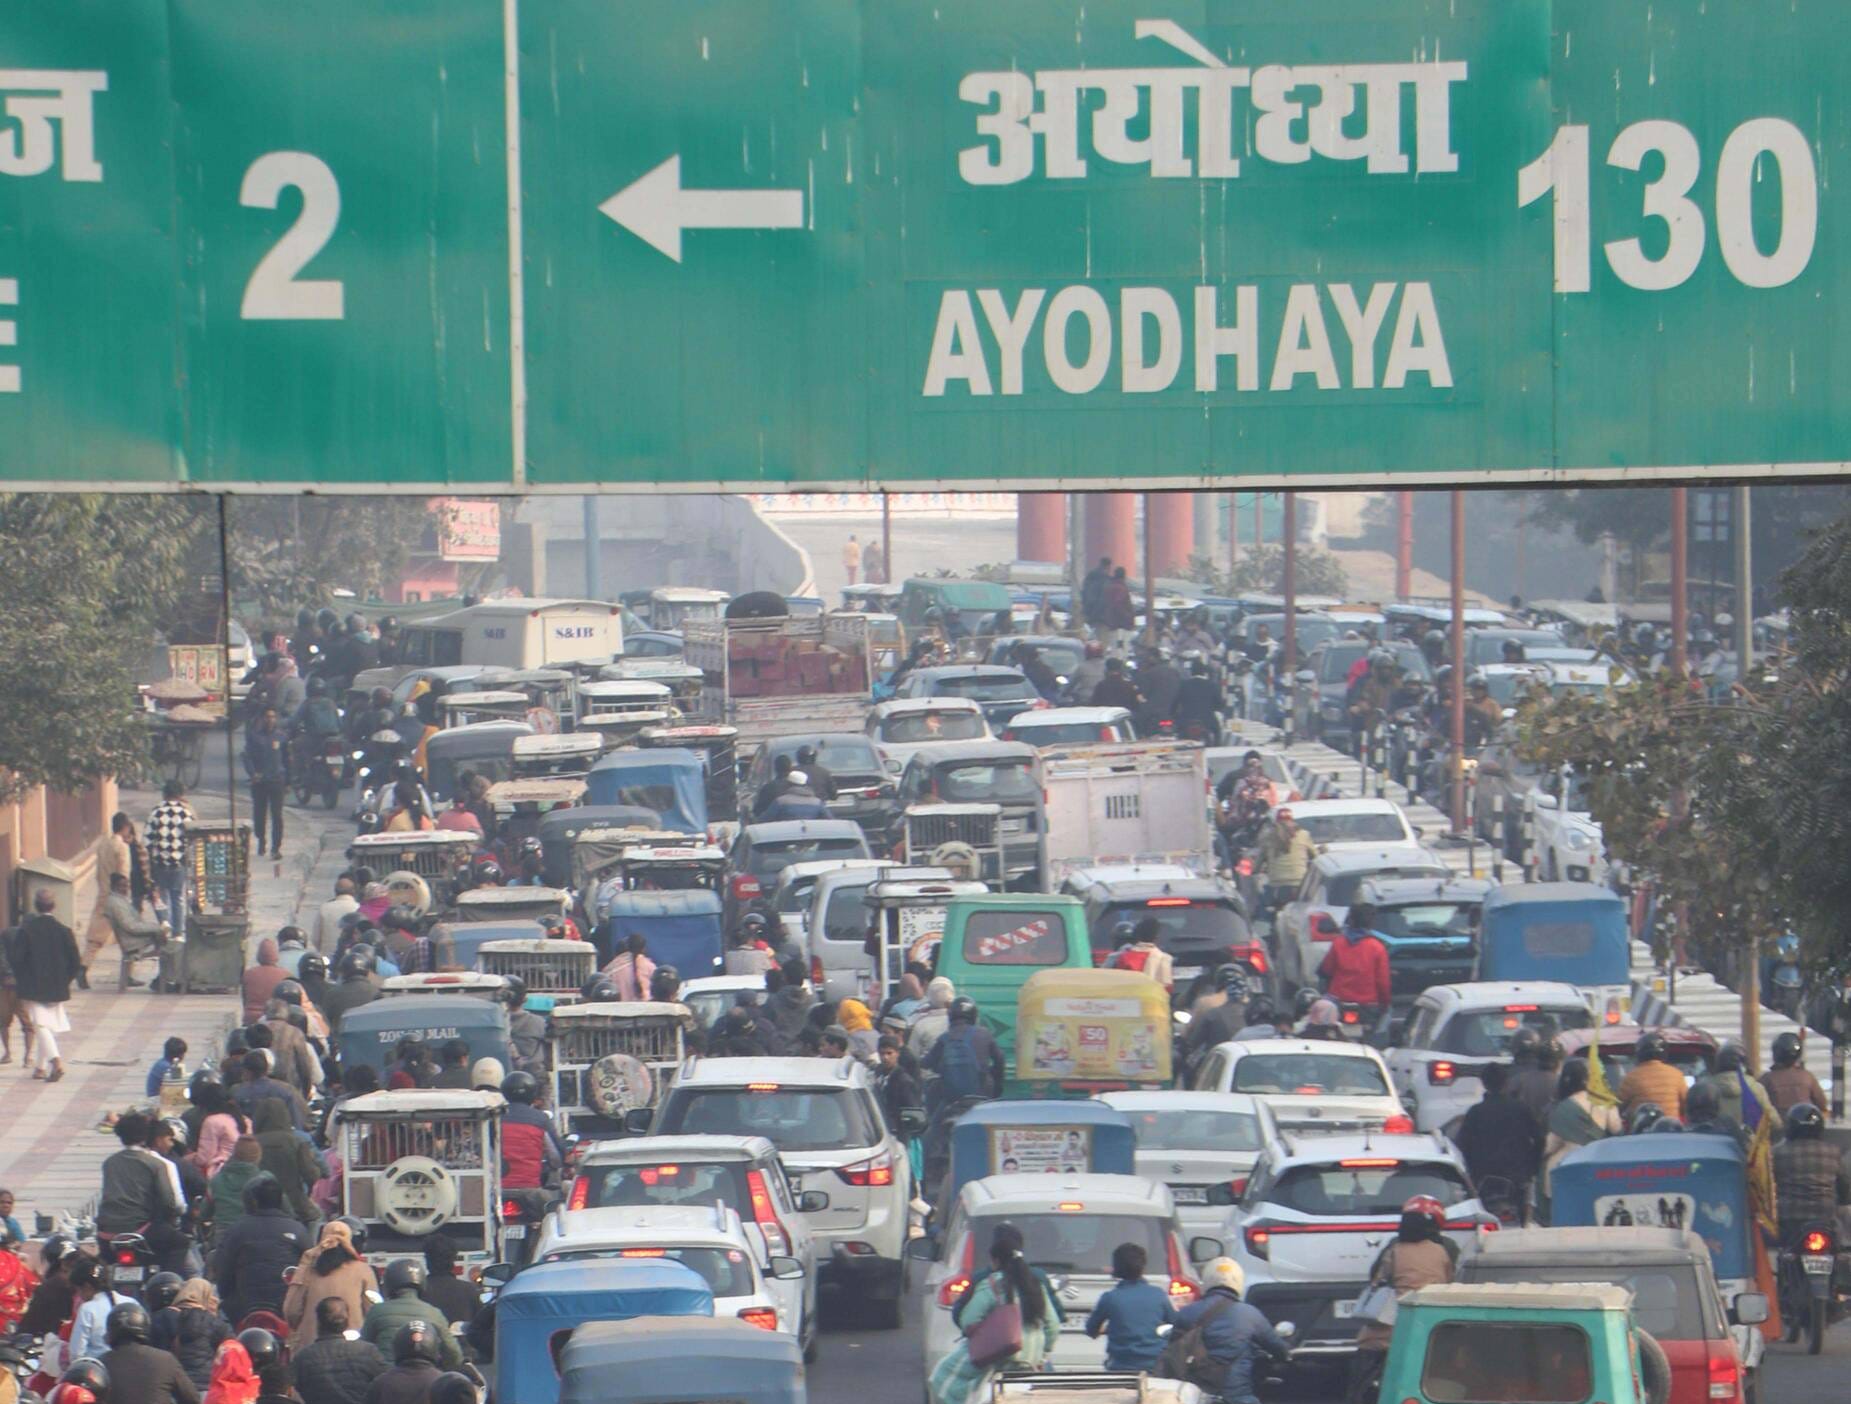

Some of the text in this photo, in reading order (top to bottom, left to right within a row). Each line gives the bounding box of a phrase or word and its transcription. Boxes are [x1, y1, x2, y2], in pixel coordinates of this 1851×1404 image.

[957, 19, 1468, 186] अयोध्या
[240, 151, 344, 319] 2
[1518, 117, 1817, 294] 130
[922, 282, 1455, 397] AYODHAYA
